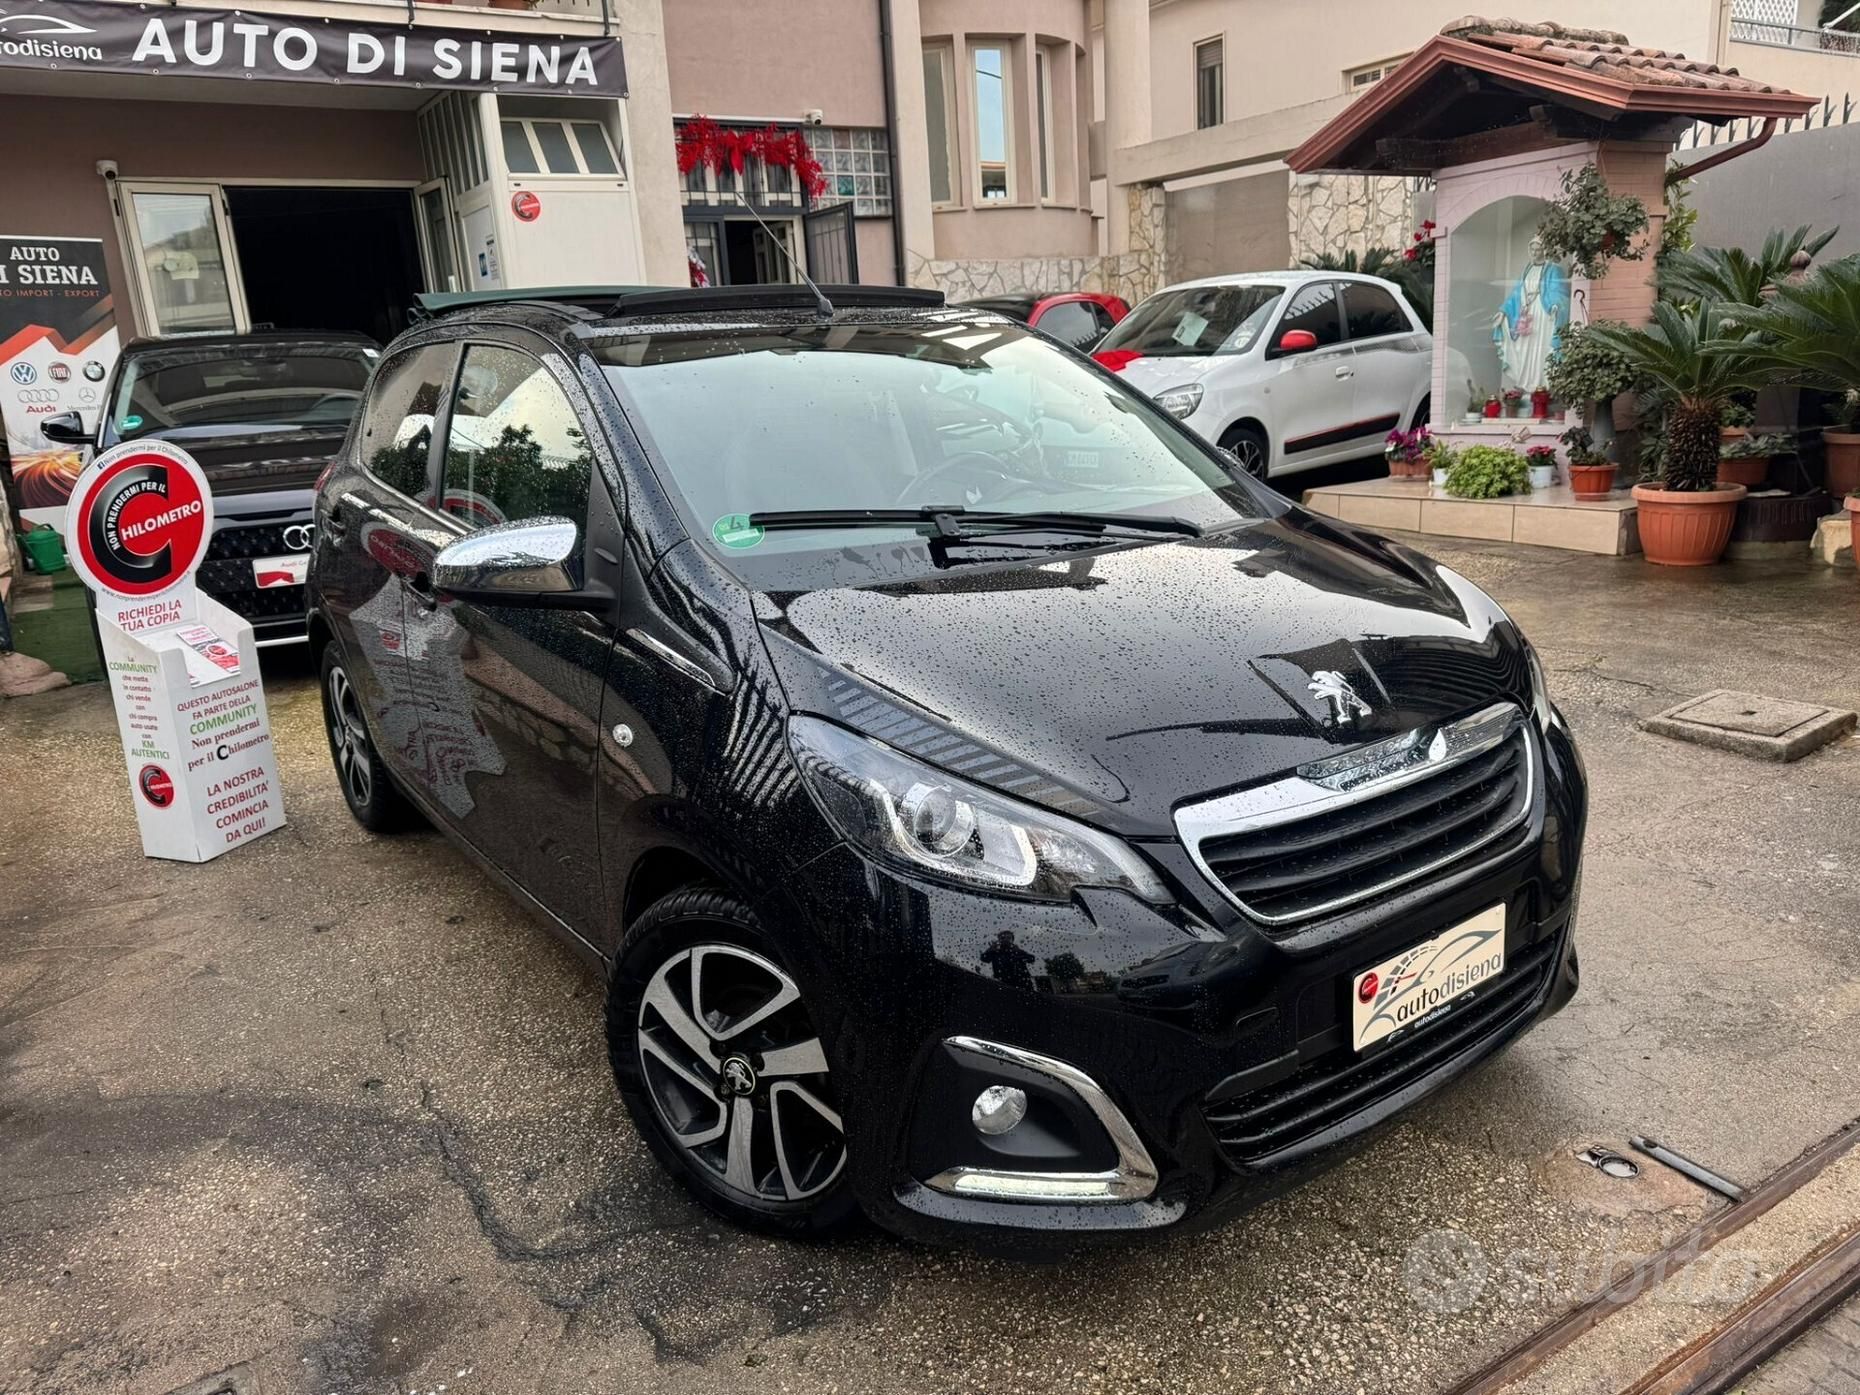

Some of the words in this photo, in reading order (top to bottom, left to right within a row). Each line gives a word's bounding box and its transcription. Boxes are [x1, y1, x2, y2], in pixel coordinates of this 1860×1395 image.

[132, 18, 318, 71] AUTO
[347, 33, 405, 76] DI
[432, 38, 598, 86] SIENA
[9, 246, 60, 261] AUTO
[18, 264, 98, 285] SIENA
[16, 289, 54, 297] IMPORT
[64, 289, 99, 297] EXPORT
[141, 481, 158, 491] PER
[158, 483, 166, 493] IL
[107, 485, 140, 528] PRENDERMI
[107, 530, 120, 550] NON
[118, 602, 166, 622] RICHIEDI
[169, 599, 182, 611] LA
[120, 619, 144, 631] TUA
[147, 611, 180, 627] COPIA
[109, 662, 158, 673] COMMUNITY
[177, 696, 210, 712] QUESTO
[211, 680, 259, 701] AUTOSALONE
[192, 711, 204, 720] FA
[204, 702, 229, 717] PARTE
[229, 695, 251, 709] DELLA
[190, 703, 257, 735] COMMUNITY
[142, 740, 155, 748] KM
[192, 737, 212, 749] Non
[214, 717, 261, 744] prendermi
[187, 757, 205, 772] per
[207, 751, 215, 762] il
[216, 734, 270, 761] Chilometro
[207, 783, 222, 796] LA
[223, 766, 264, 791] NOSTRA
[216, 800, 269, 829] COMINCIA
[226, 829, 241, 843] DA
[243, 817, 267, 835] QUI!
[1397, 951, 1502, 1022] autodisiena
